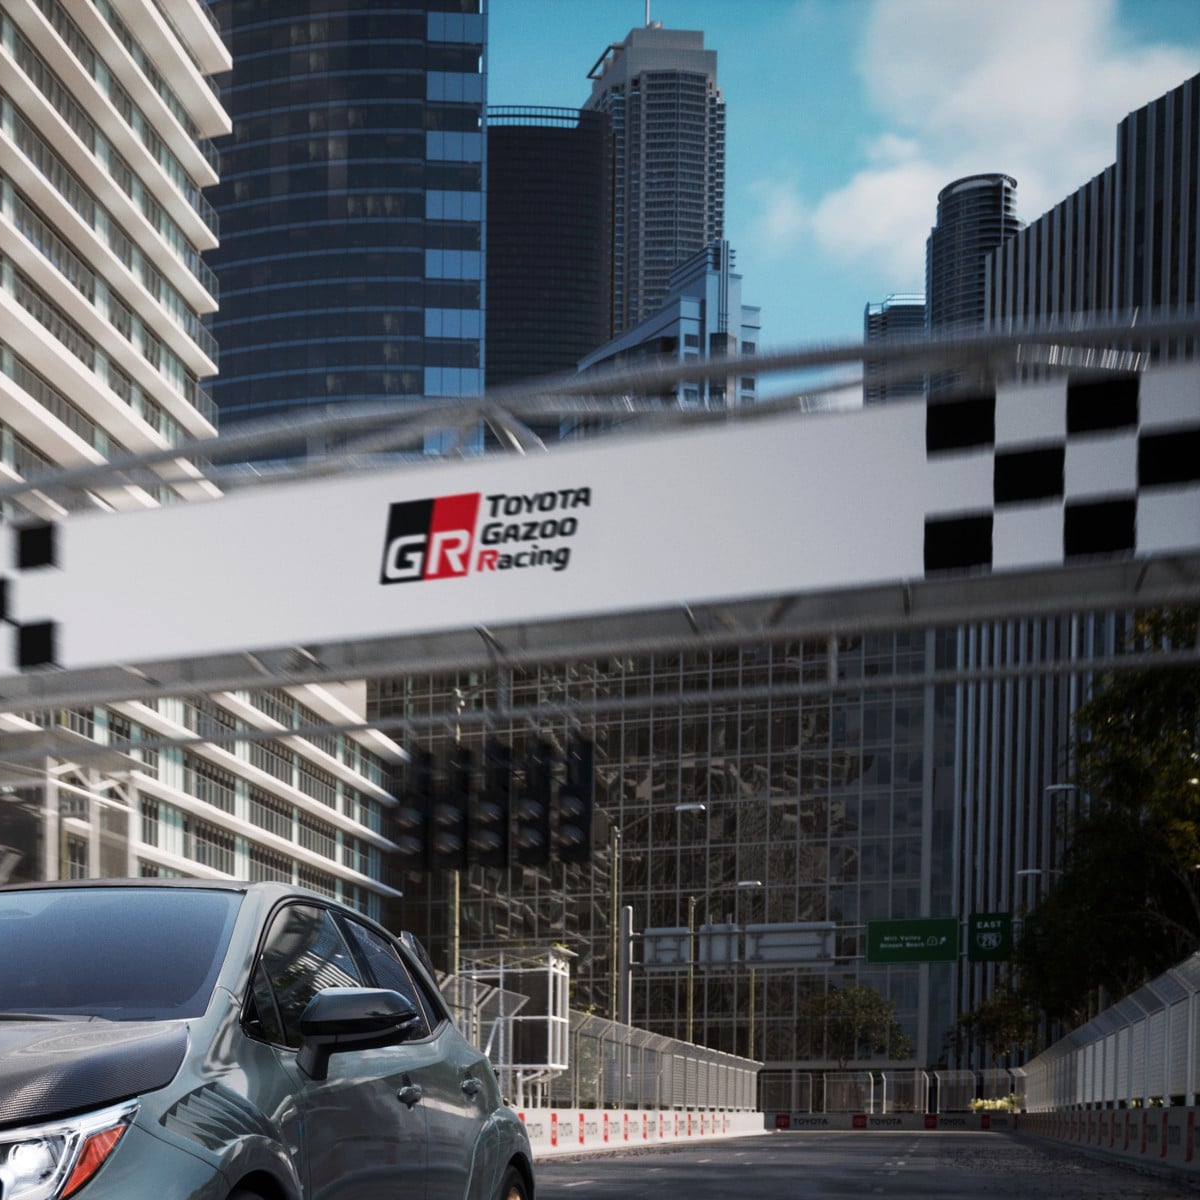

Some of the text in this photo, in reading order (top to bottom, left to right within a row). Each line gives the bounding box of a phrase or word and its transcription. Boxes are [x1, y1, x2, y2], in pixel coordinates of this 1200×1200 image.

[486, 487, 591, 517] TOYOTA
[481, 517, 578, 545] GAZOO
[385, 529, 471, 579] GR
[476, 545, 571, 572] Racing
[977, 920, 1002, 929] EAST
[793, 1118, 829, 1126] TOYOTA
[870, 1118, 903, 1126] TOYOTA
